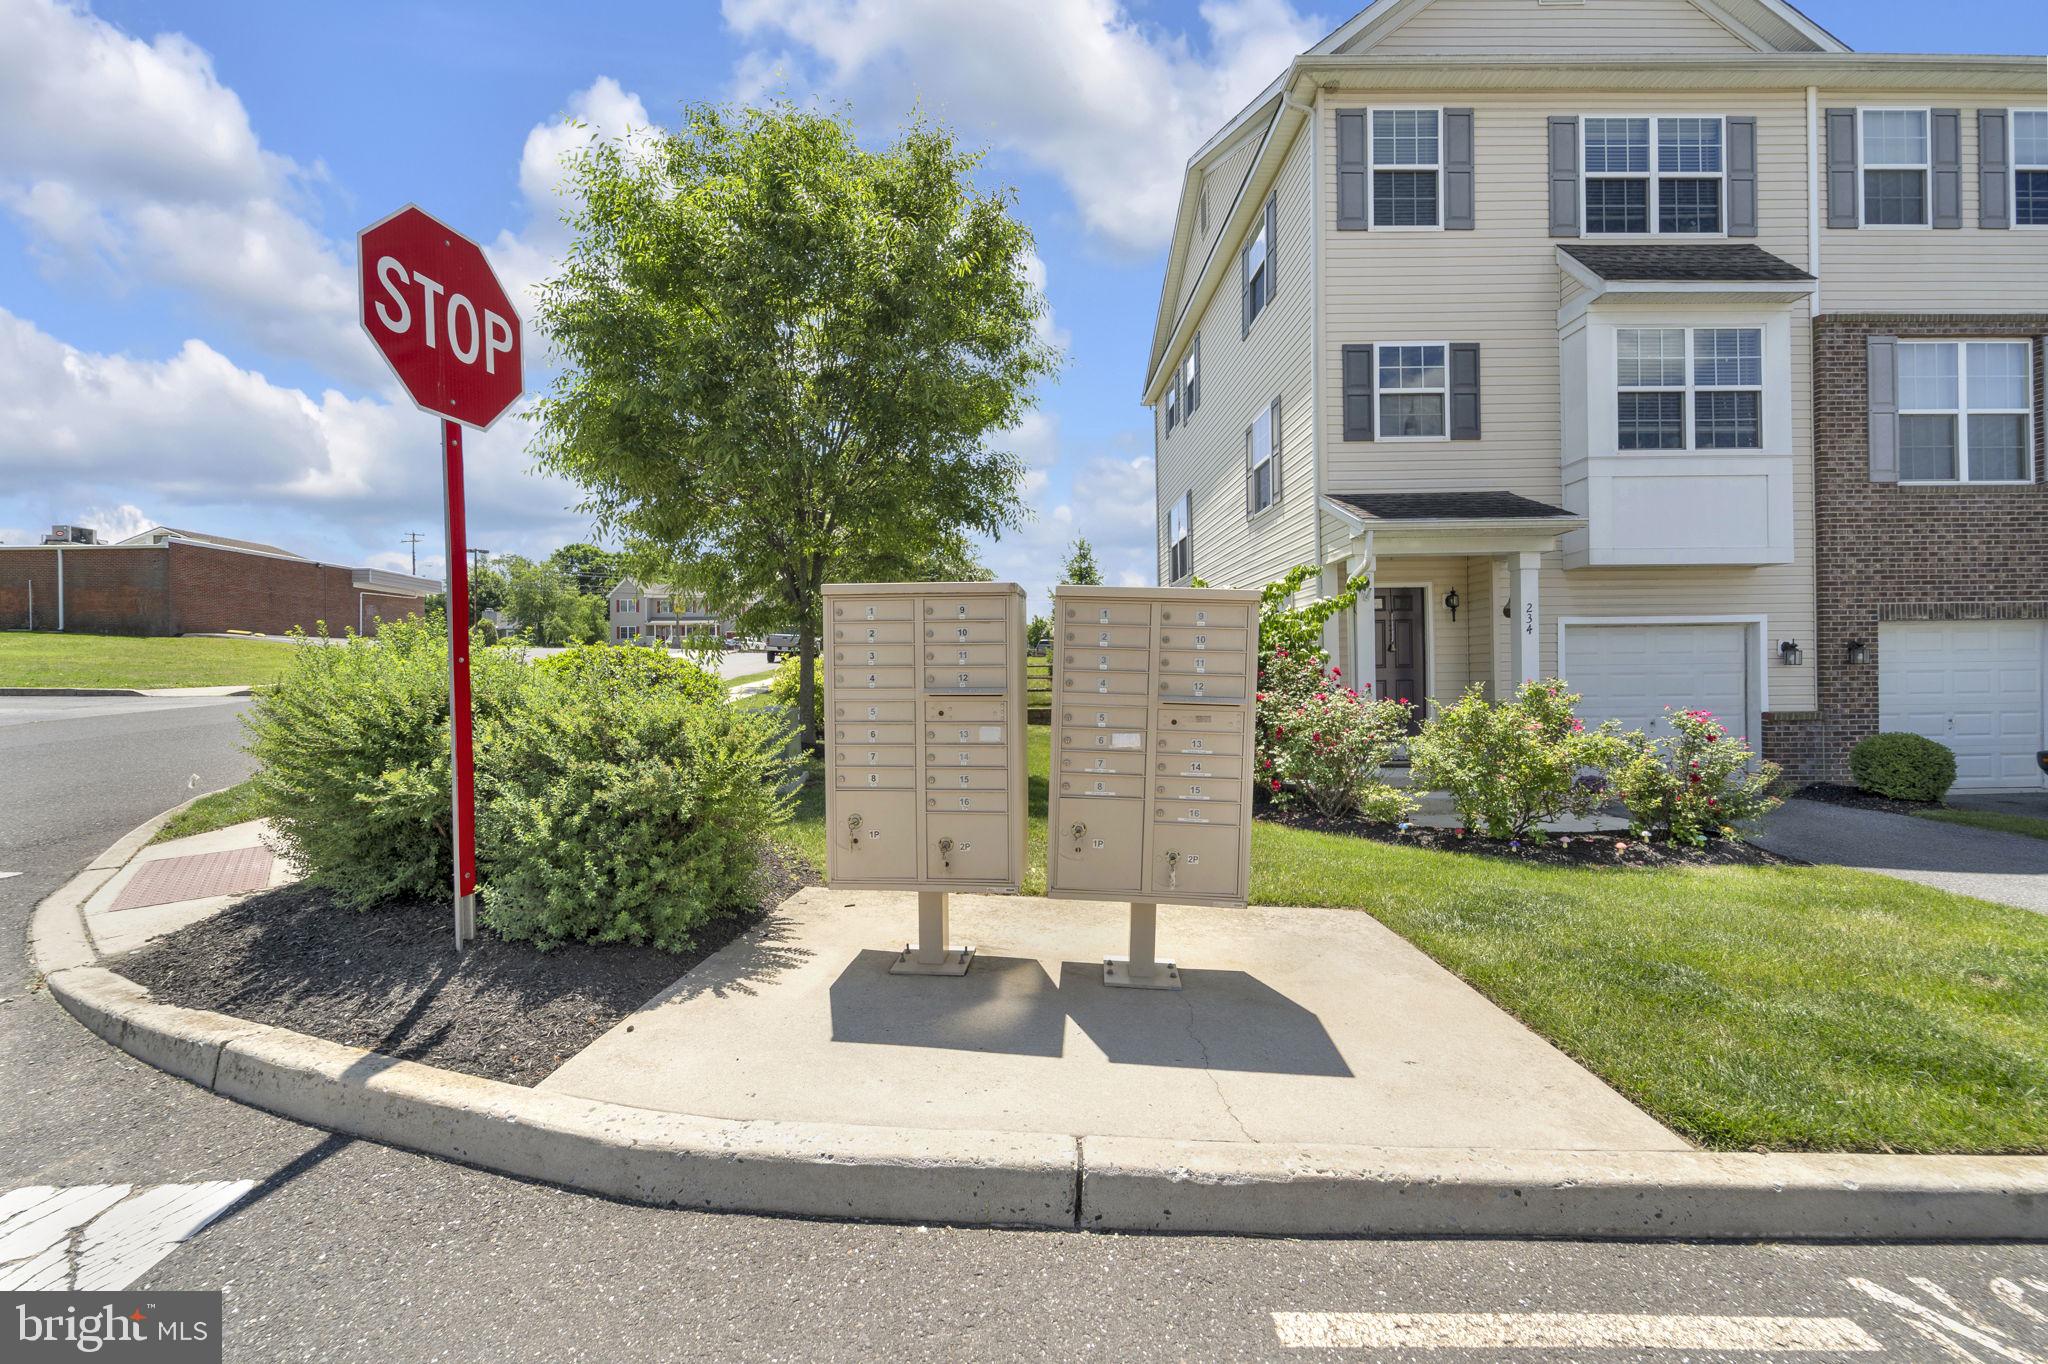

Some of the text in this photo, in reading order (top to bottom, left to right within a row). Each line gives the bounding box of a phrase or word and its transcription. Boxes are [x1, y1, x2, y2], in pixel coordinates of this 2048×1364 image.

[374, 255, 514, 375] STOP
[1525, 602, 1533, 635] 234
[958, 628, 968, 636] 10
[1195, 635, 1206, 643] 10
[958, 651, 967, 659] 11
[1195, 659, 1205, 667] 11
[958, 674, 968, 682] 12
[1194, 682, 1204, 690] 12
[959, 730, 969, 738] 13
[1191, 740, 1202, 748] 13
[1191, 763, 1201, 771] 14
[1190, 786, 1201, 794] 15
[1189, 809, 1200, 817] 16
[869, 830, 880, 839] 1P
[959, 842, 971, 851] 2P
[1093, 839, 1104, 848] 1P
[1187, 854, 1199, 863] 2P
